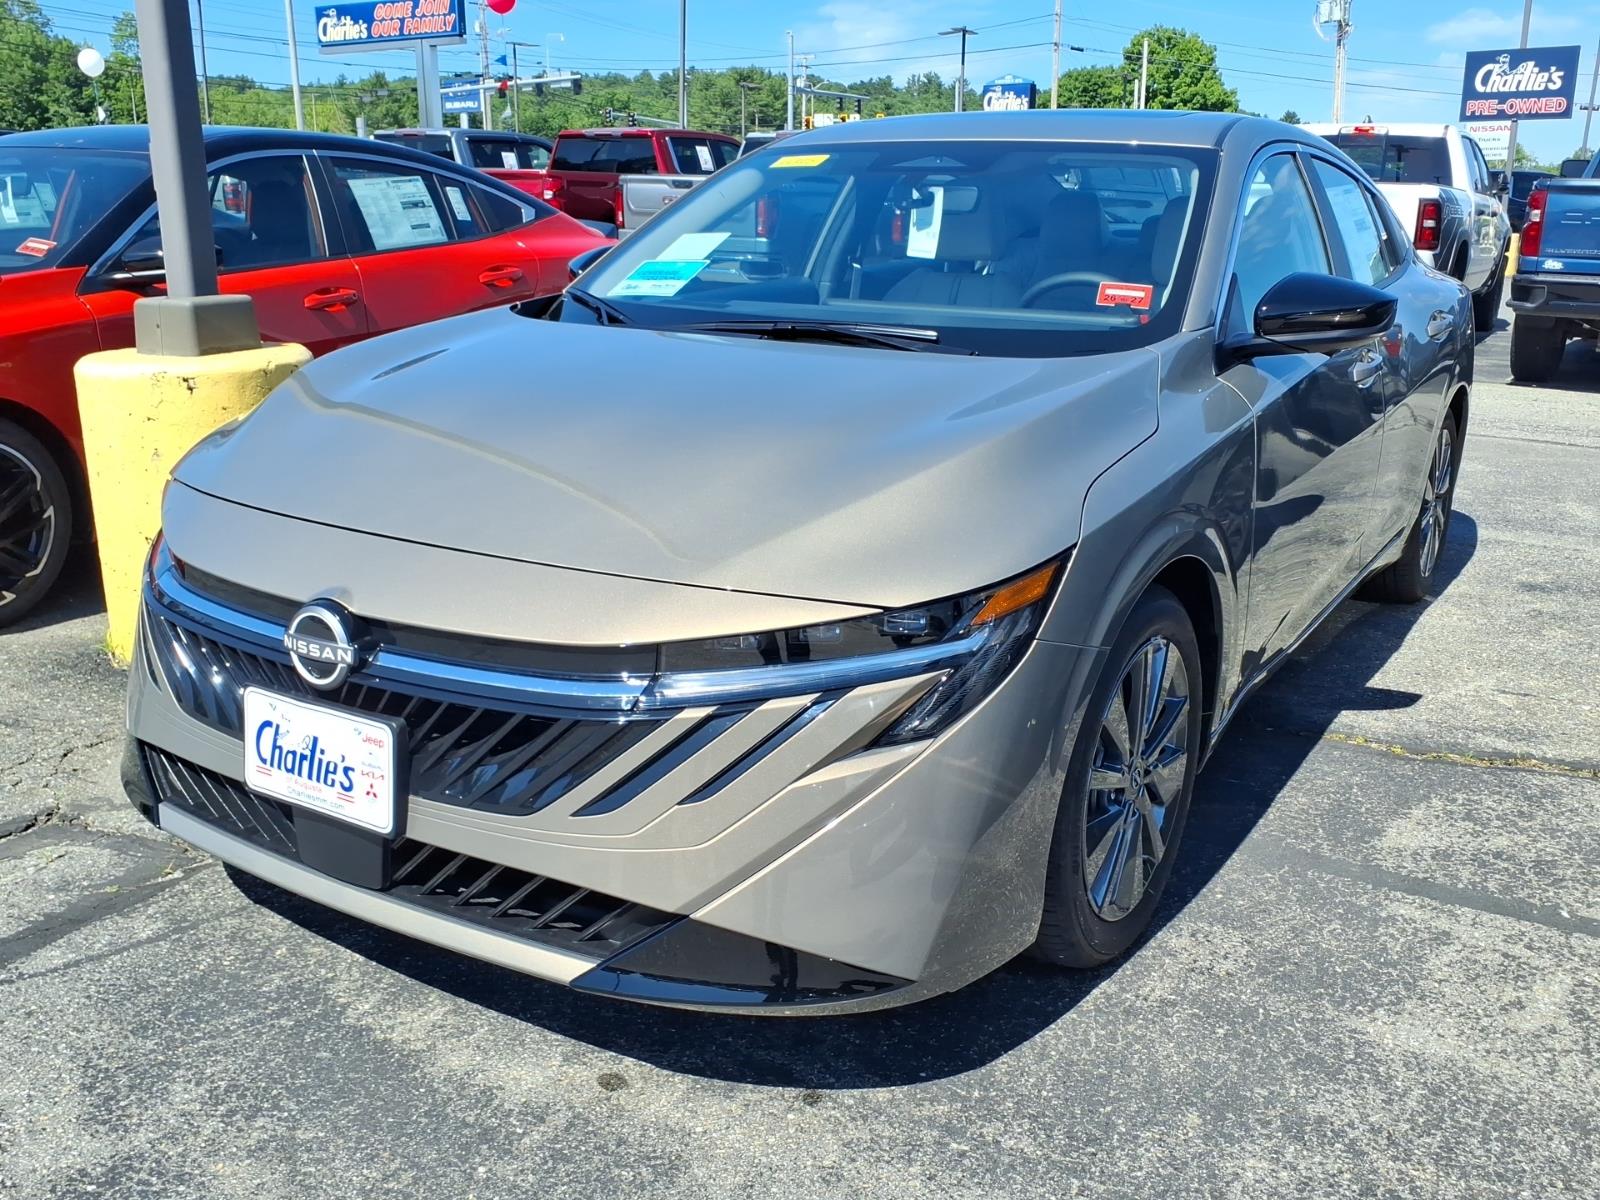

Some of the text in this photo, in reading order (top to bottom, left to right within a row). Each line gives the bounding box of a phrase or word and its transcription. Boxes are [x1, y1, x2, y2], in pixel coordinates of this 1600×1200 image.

[374, 0, 450, 20] COME JOIN
[318, 15, 368, 42] Charlie's
[371, 12, 456, 37] OUR FAMILY
[1474, 60, 1565, 93] Charlie's
[445, 100, 479, 110] SUBARU
[983, 91, 1029, 112] Charlie's
[1466, 98, 1567, 116] PRE-OWNED
[1469, 125, 1512, 133] NISSAN
[283, 634, 353, 664] NISSAN
[361, 733, 386, 749] Jeep
[256, 720, 356, 794] Charlie's
